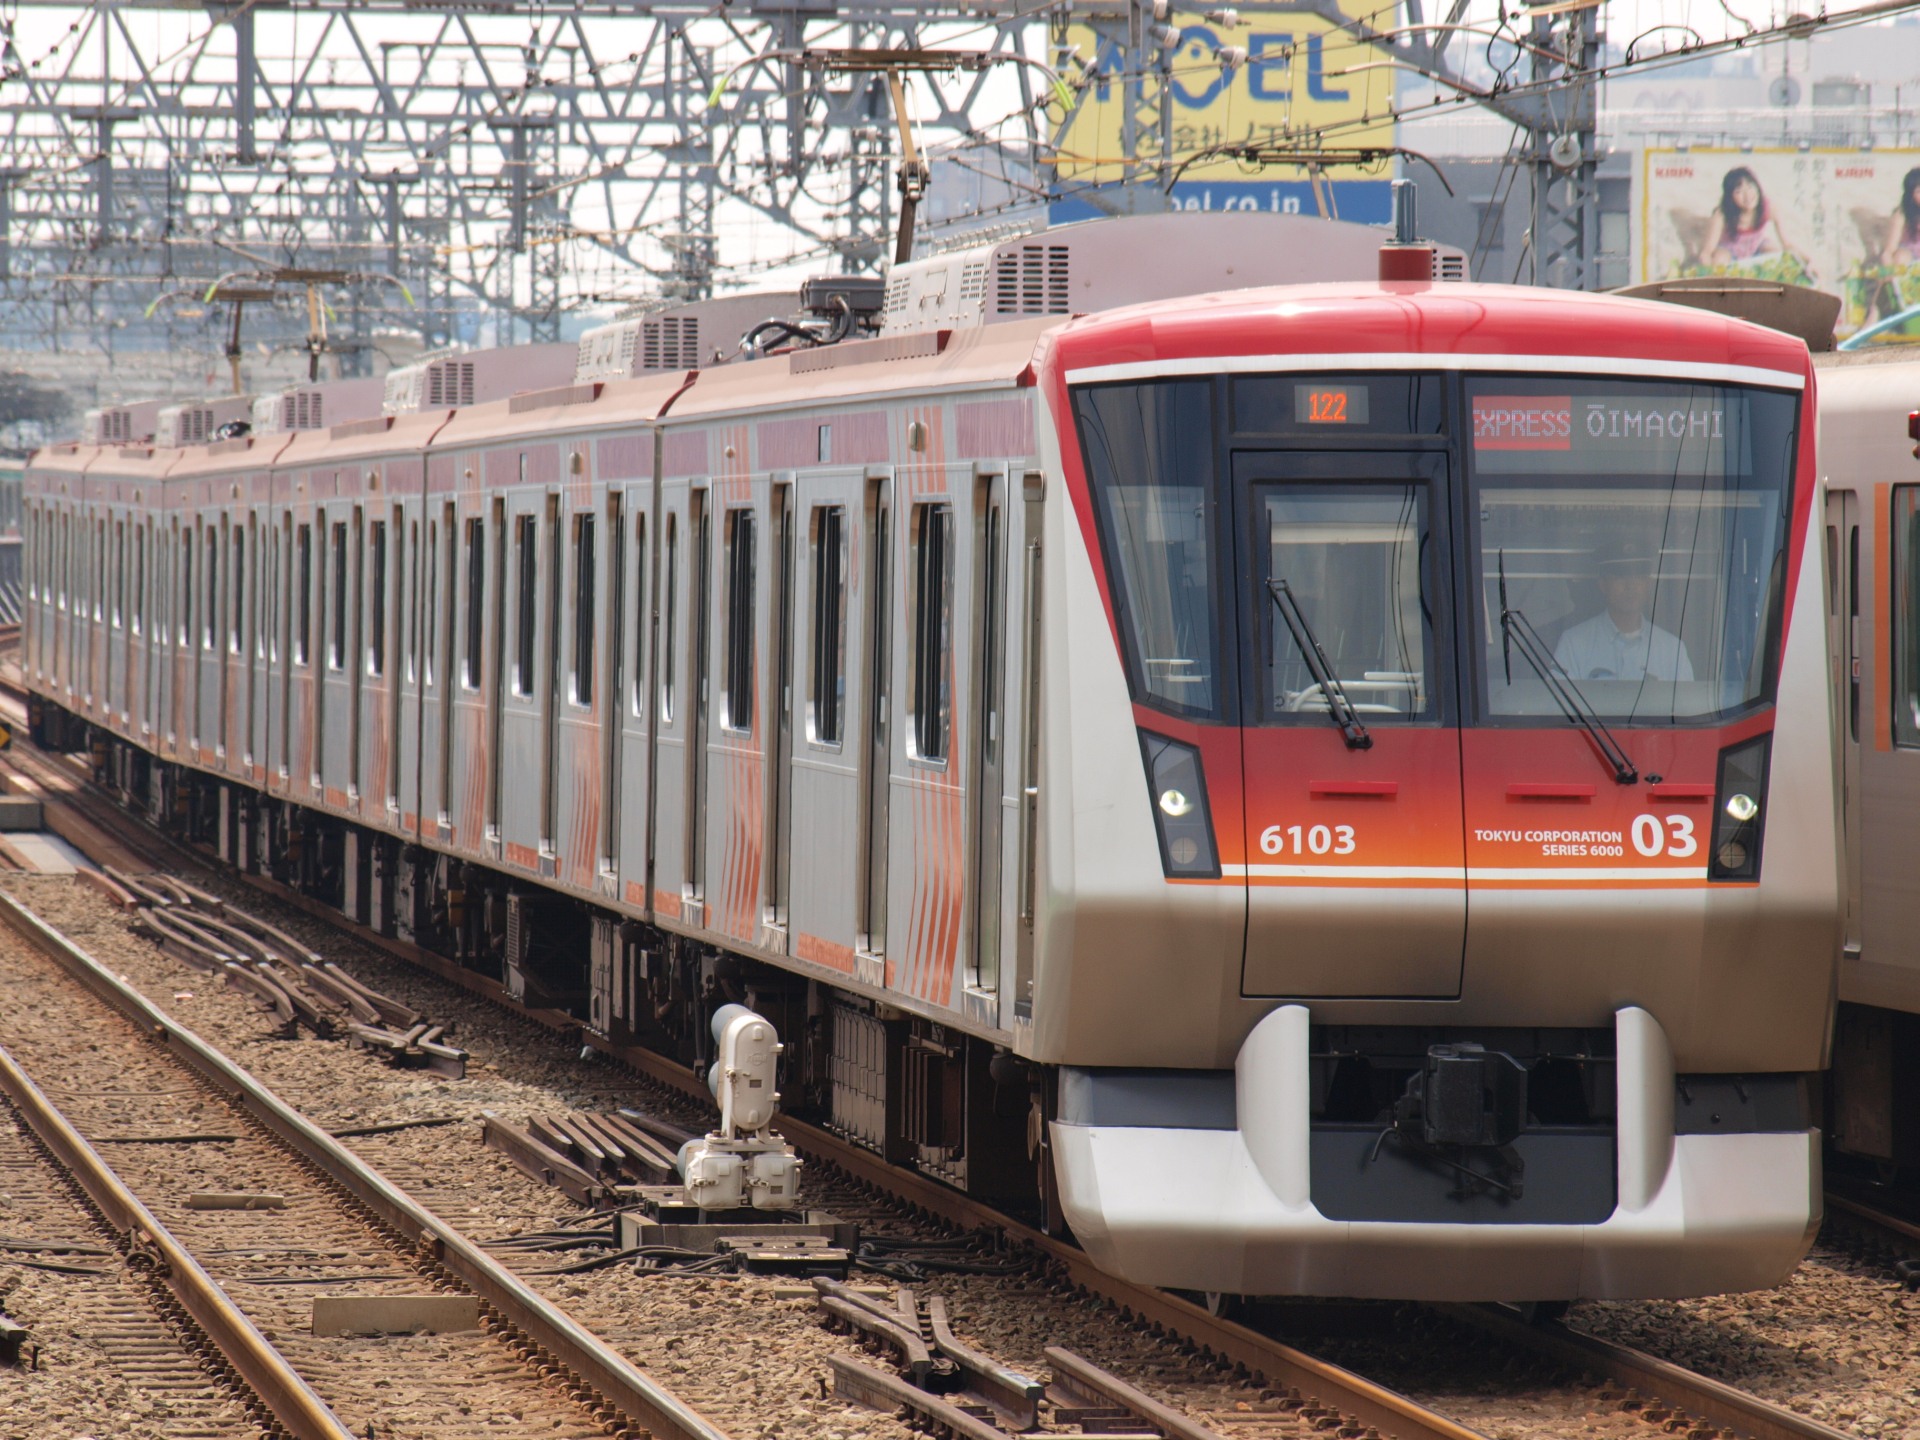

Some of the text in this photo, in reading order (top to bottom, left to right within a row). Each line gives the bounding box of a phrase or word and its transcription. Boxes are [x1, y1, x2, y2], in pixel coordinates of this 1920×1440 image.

[1309, 392, 1347, 421] 122
[1473, 409, 1571, 437] EXPRESS
[1260, 825, 1356, 855] 6103
[1475, 829, 1622, 843] TOKYU CORPORATION
[1631, 813, 1698, 858] 03
[1542, 844, 1624, 857] SERIES 6000
